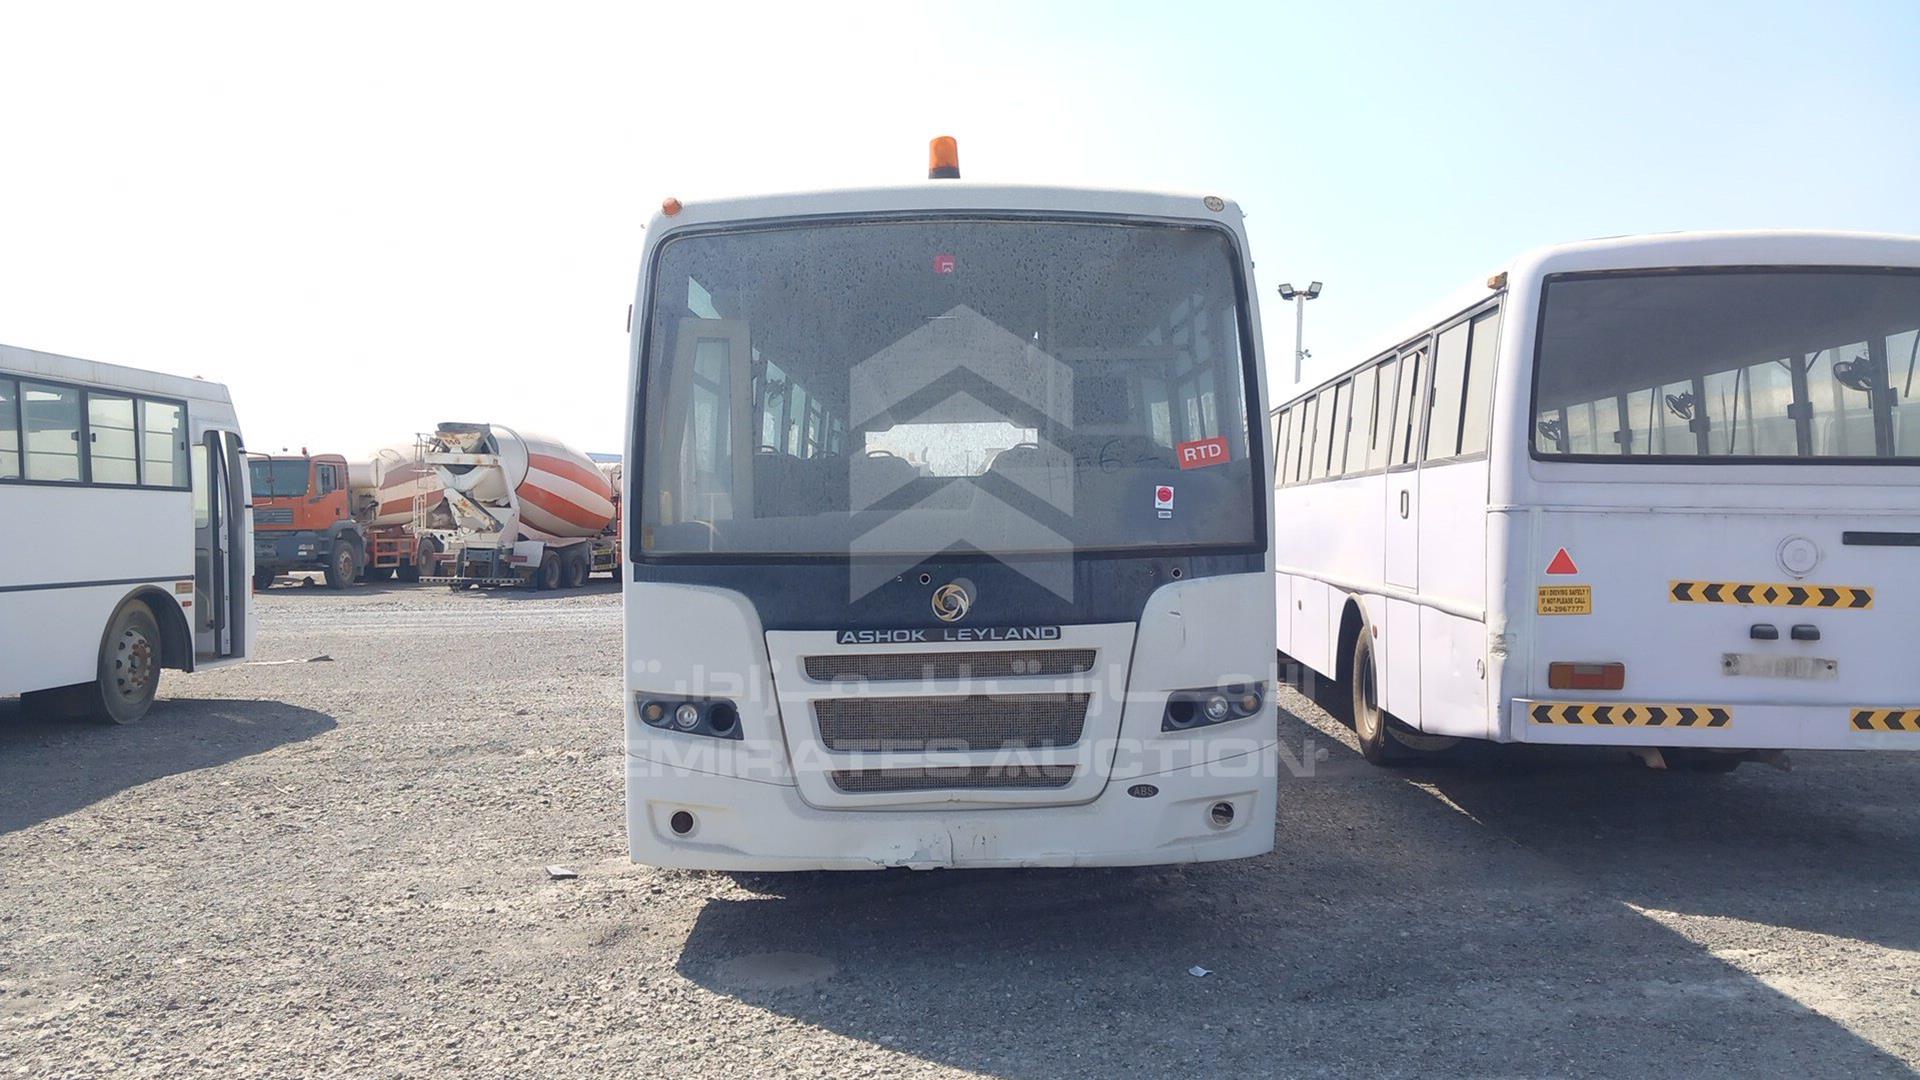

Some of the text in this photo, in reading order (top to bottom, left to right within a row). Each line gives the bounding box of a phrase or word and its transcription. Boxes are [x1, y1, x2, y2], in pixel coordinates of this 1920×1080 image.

[1183, 443, 1222, 462] RTD
[840, 626, 1058, 643] ASHOK LEYLAND
[1134, 786, 1154, 796] ABS
